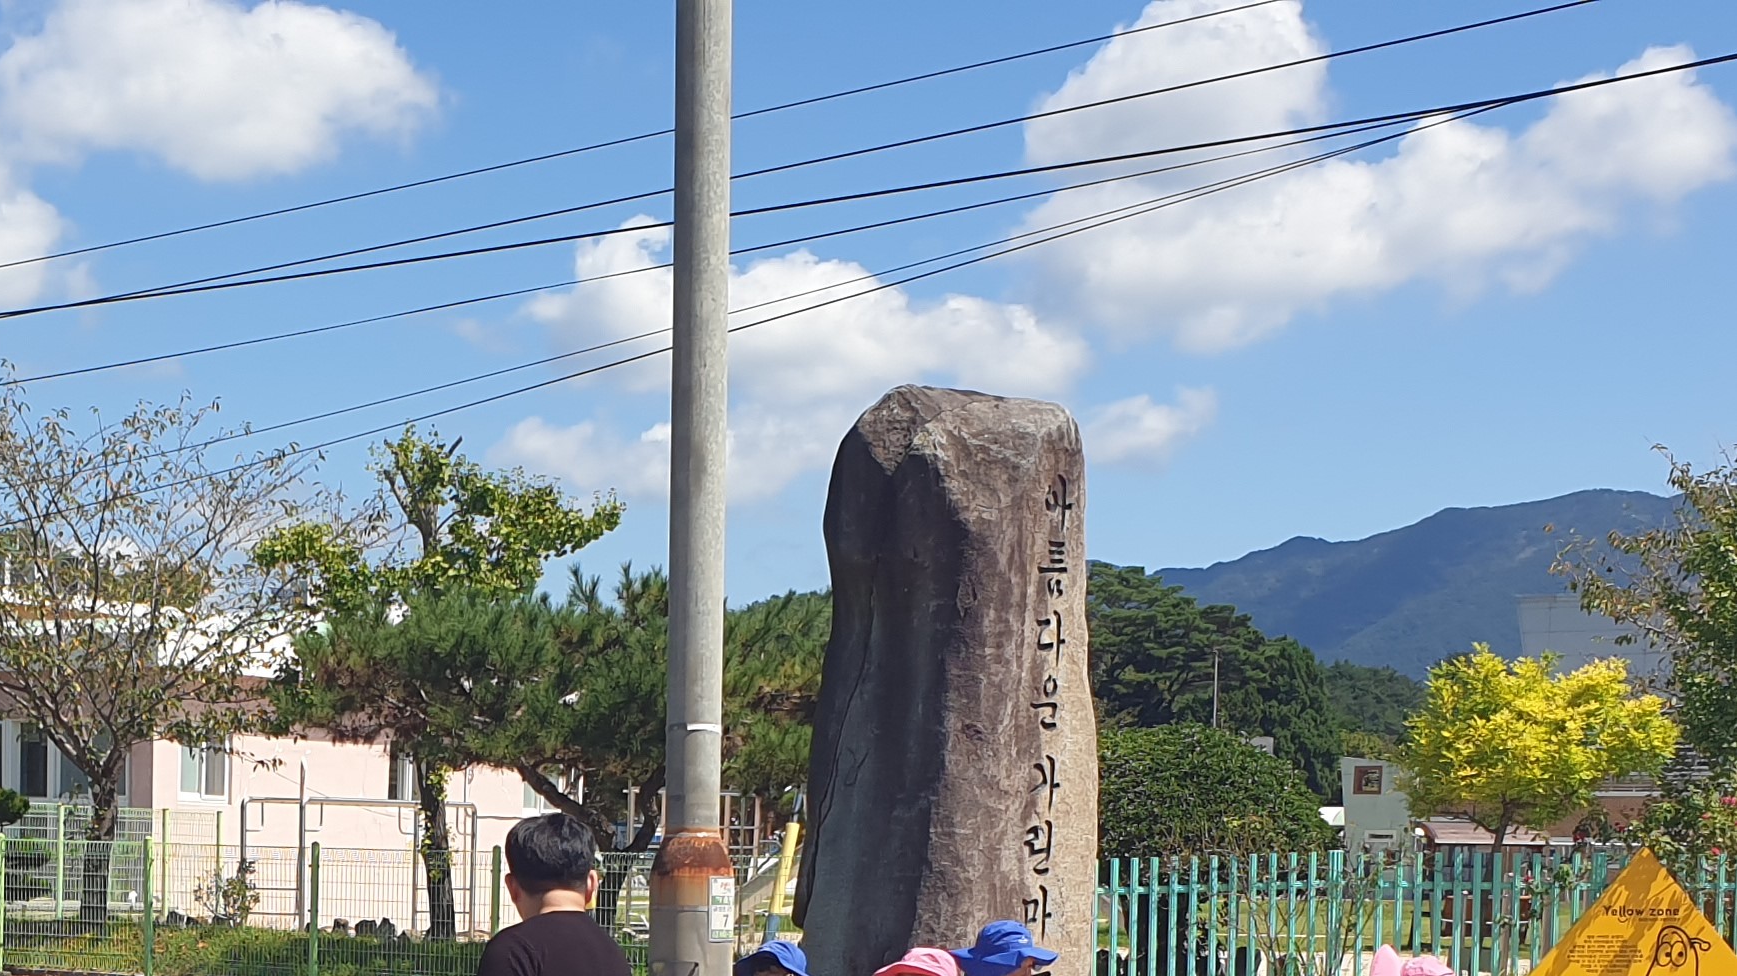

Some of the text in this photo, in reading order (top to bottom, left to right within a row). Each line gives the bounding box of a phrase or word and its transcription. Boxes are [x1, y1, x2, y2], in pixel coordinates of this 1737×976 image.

[1029, 473, 1073, 730] 아름다운
[1603, 905, 1680, 918] Yellow zone
[723, 914, 729, 928] 7
